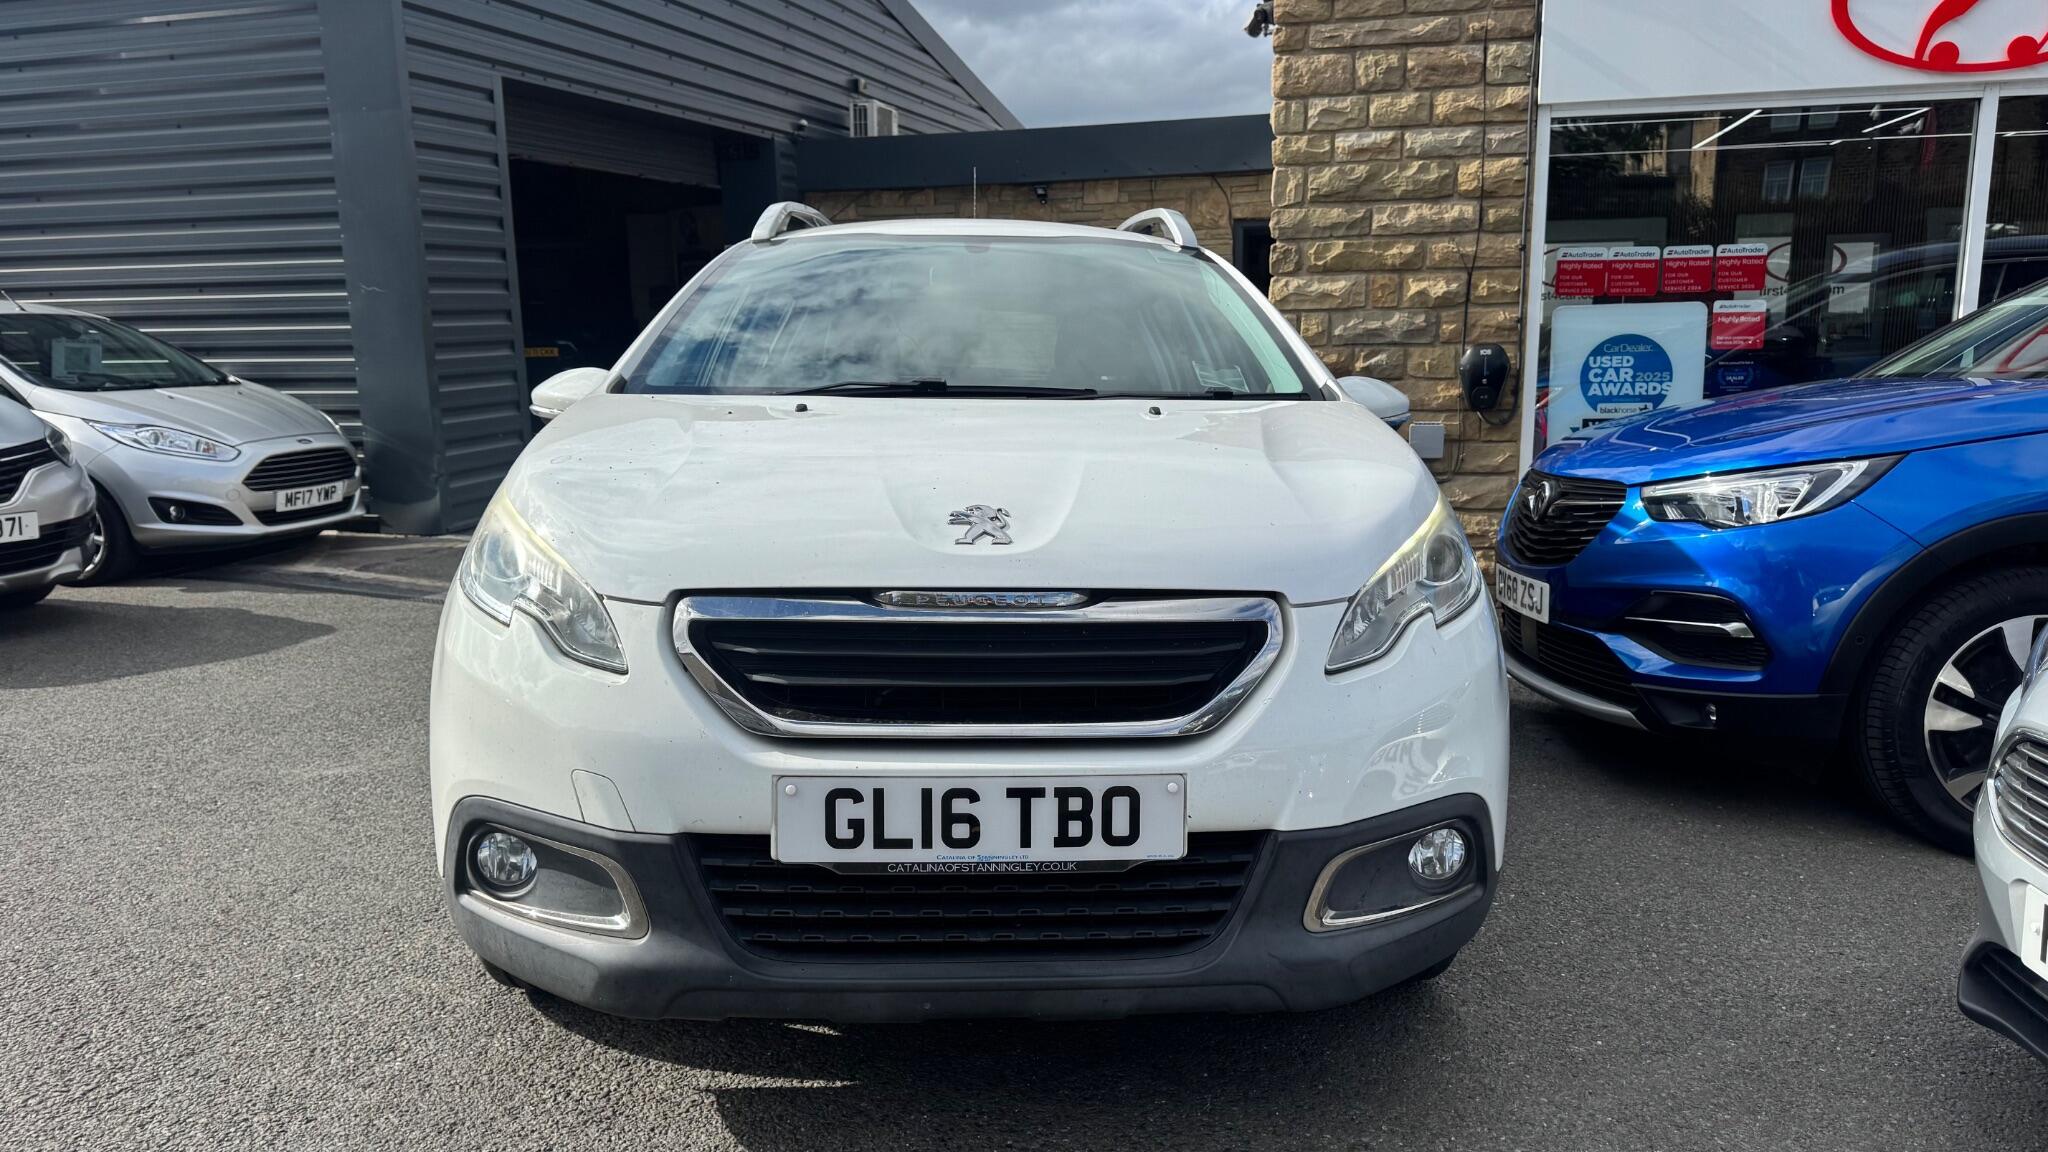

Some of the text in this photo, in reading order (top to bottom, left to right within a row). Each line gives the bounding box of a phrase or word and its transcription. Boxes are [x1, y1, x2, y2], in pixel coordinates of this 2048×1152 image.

[1588, 355, 1635, 368] USED
[1588, 368, 1670, 382] CAR 2025
[1587, 381, 1672, 396] AWARDS
[1600, 405, 1638, 414] blackhorse
[285, 489, 313, 508] MF17
[916, 593, 1046, 607] PEUGEOT
[1520, 579, 1543, 615] ZSJ
[825, 786, 1141, 850] GL16 TBO
[887, 862, 1077, 873] CATALINAOFSTANNINGLEY.CO.UK
